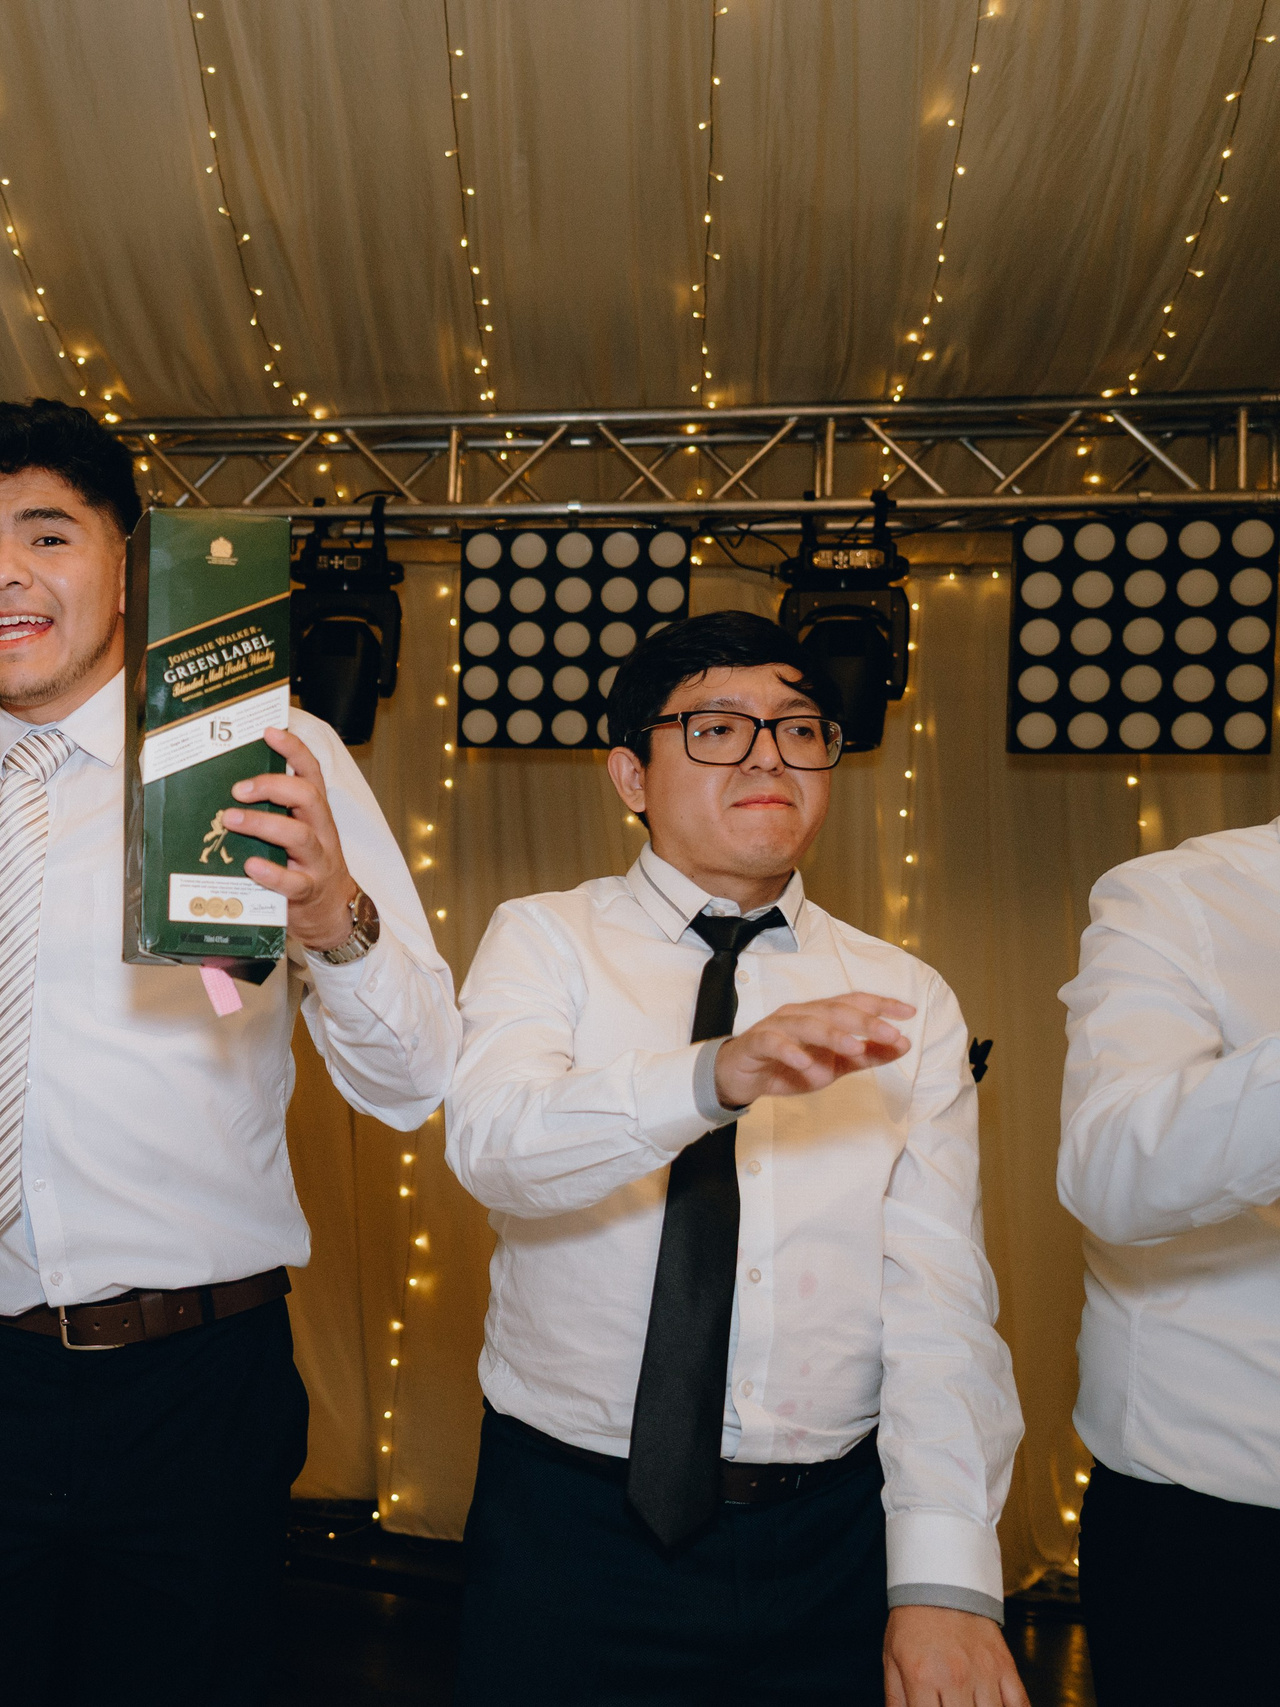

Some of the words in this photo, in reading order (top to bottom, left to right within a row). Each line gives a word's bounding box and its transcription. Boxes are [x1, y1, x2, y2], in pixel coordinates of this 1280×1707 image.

[163, 653, 219, 684] GREEN
[221, 634, 272, 662] LABEL
[168, 641, 215, 667] JOHNNIE
[209, 720, 232, 742] 15
